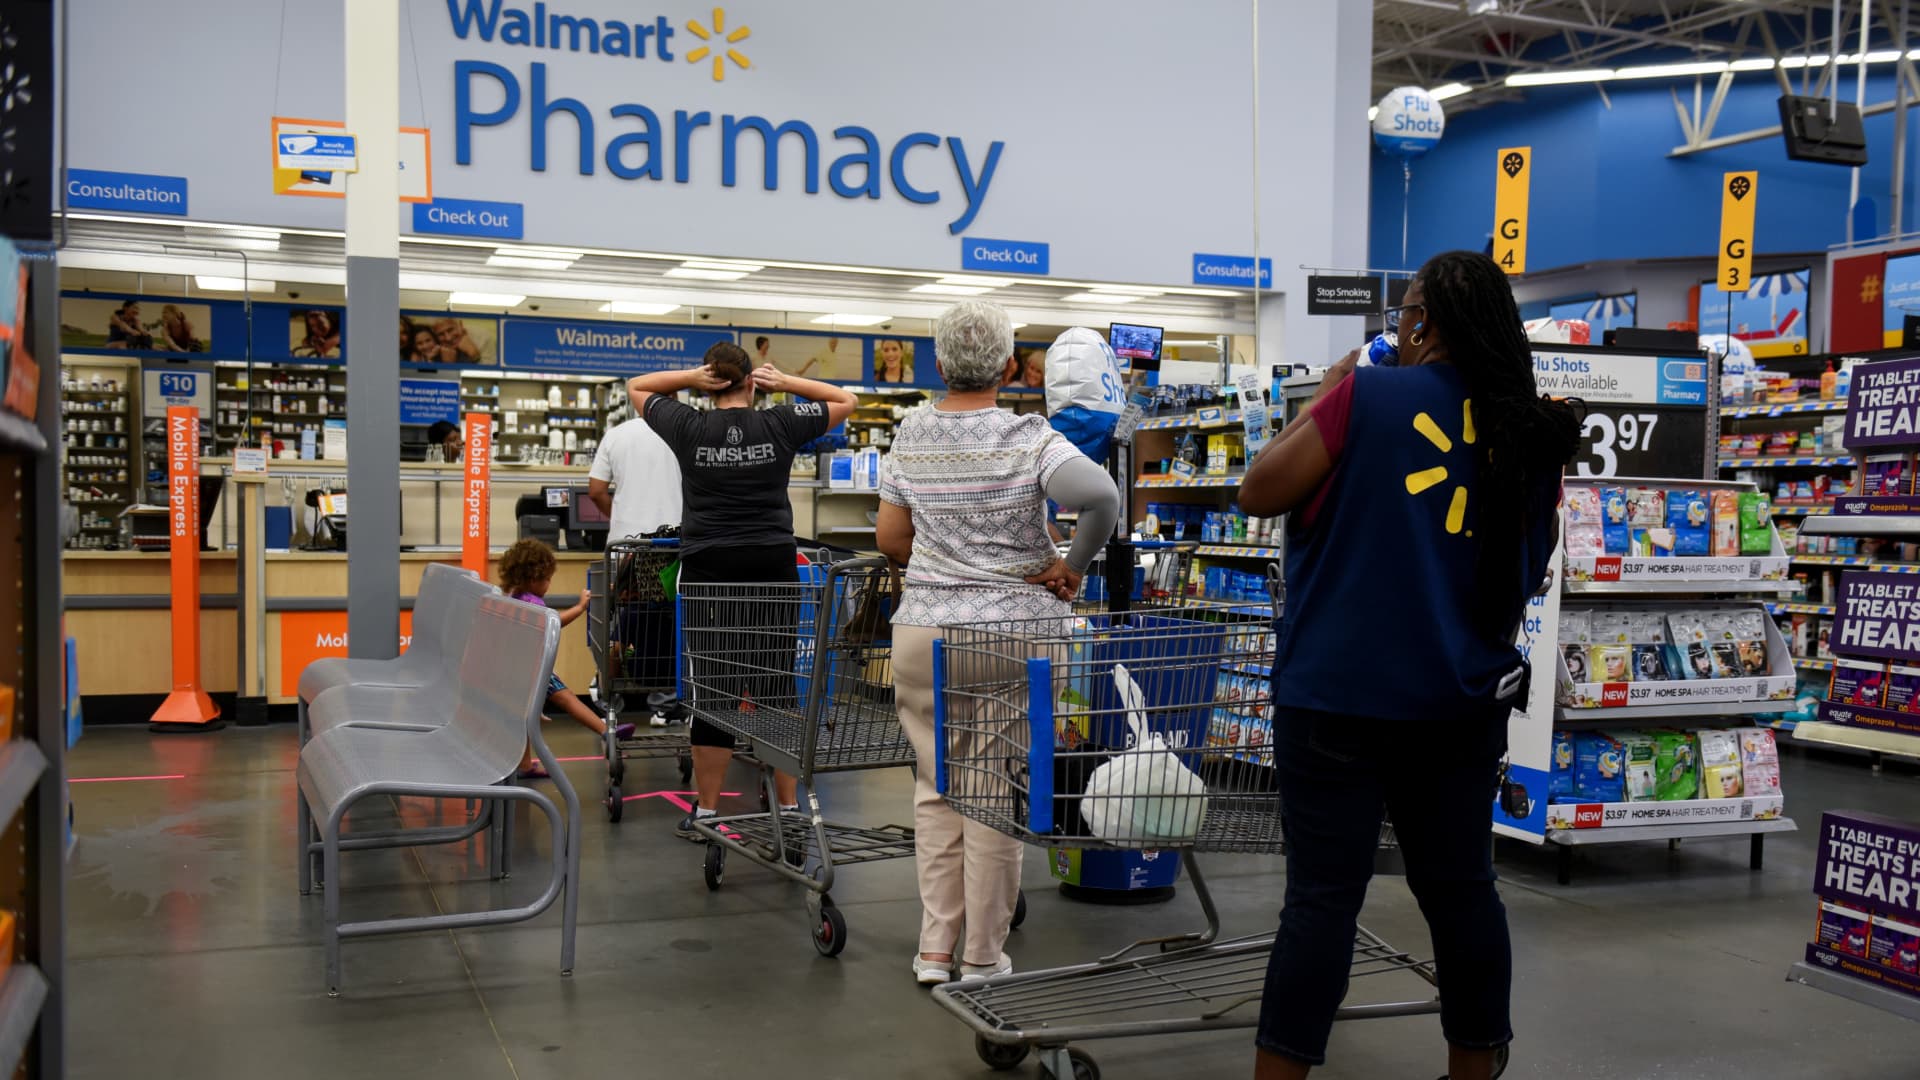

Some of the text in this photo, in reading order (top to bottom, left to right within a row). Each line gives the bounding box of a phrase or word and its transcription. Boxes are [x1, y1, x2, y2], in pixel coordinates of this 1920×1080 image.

[446, 0, 674, 61] Walmart
[1404, 95, 1430, 111] Flu
[1394, 113, 1440, 133] Shots
[323, 141, 345, 149] Security
[455, 59, 1005, 235] Pharmacy
[68, 181, 180, 203] Consultation
[428, 208, 509, 227] Check Out
[1501, 218, 1519, 268] G 4
[974, 247, 1038, 264] Check Out
[1726, 239, 1745, 286] G 3
[1198, 262, 1268, 279] Consultatin
[1317, 287, 1371, 299] Stop Smoking
[557, 328, 685, 351] Walmart.com
[1552, 357, 1590, 373] Shots
[163, 375, 193, 391] $10
[1561, 375, 1618, 391] Available
[1860, 368, 1920, 389] 1 TABLET
[1664, 389, 1701, 401] Pharmacy
[1858, 385, 1920, 408] TREAT
[696, 443, 775, 462] FINISHER
[171, 416, 189, 537] Mobile Express
[466, 423, 487, 538] Mobile Express
[1597, 564, 1744, 574] NEW $3.97 HOME SPA HAIR TREATMENT
[1849, 583, 1855, 596] 1
[1858, 584, 1914, 599] TABLET
[1846, 598, 1920, 620] TREATS
[1604, 685, 1752, 700] NEW $3.97 HOME SPA HAIR TREATMENT
[1829, 709, 1852, 718] equate
[1855, 714, 1895, 727] Omeprazole
[1577, 806, 1736, 822] NEW $3.97 HOME SPA HAIR TREATMENT
[1830, 824, 1920, 858] 1 TABLET EV
[1828, 839, 1905, 875] TREATS
